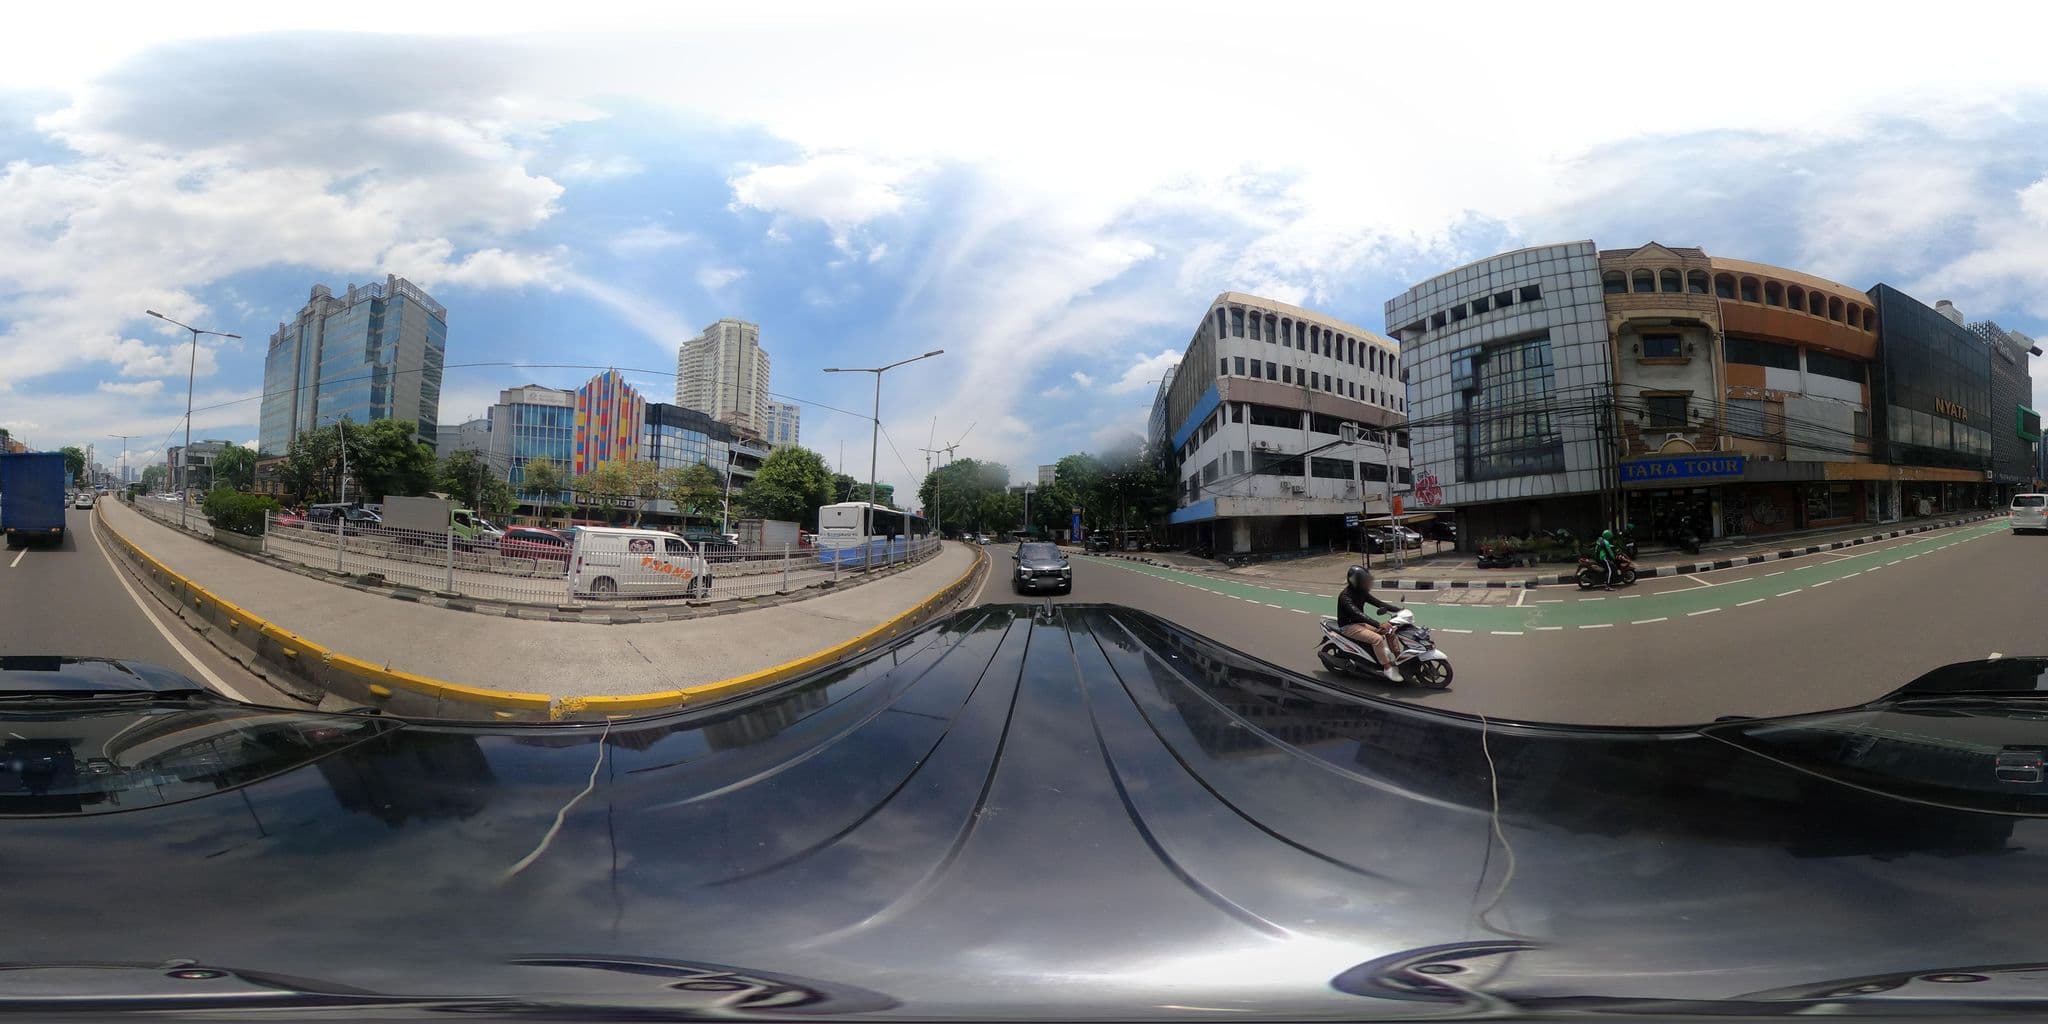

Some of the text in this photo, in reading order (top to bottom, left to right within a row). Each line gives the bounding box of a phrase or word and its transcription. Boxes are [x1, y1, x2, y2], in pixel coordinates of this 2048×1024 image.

[1935, 397, 1968, 420] NYATA
[1626, 460, 1737, 478] TARA TOUR
